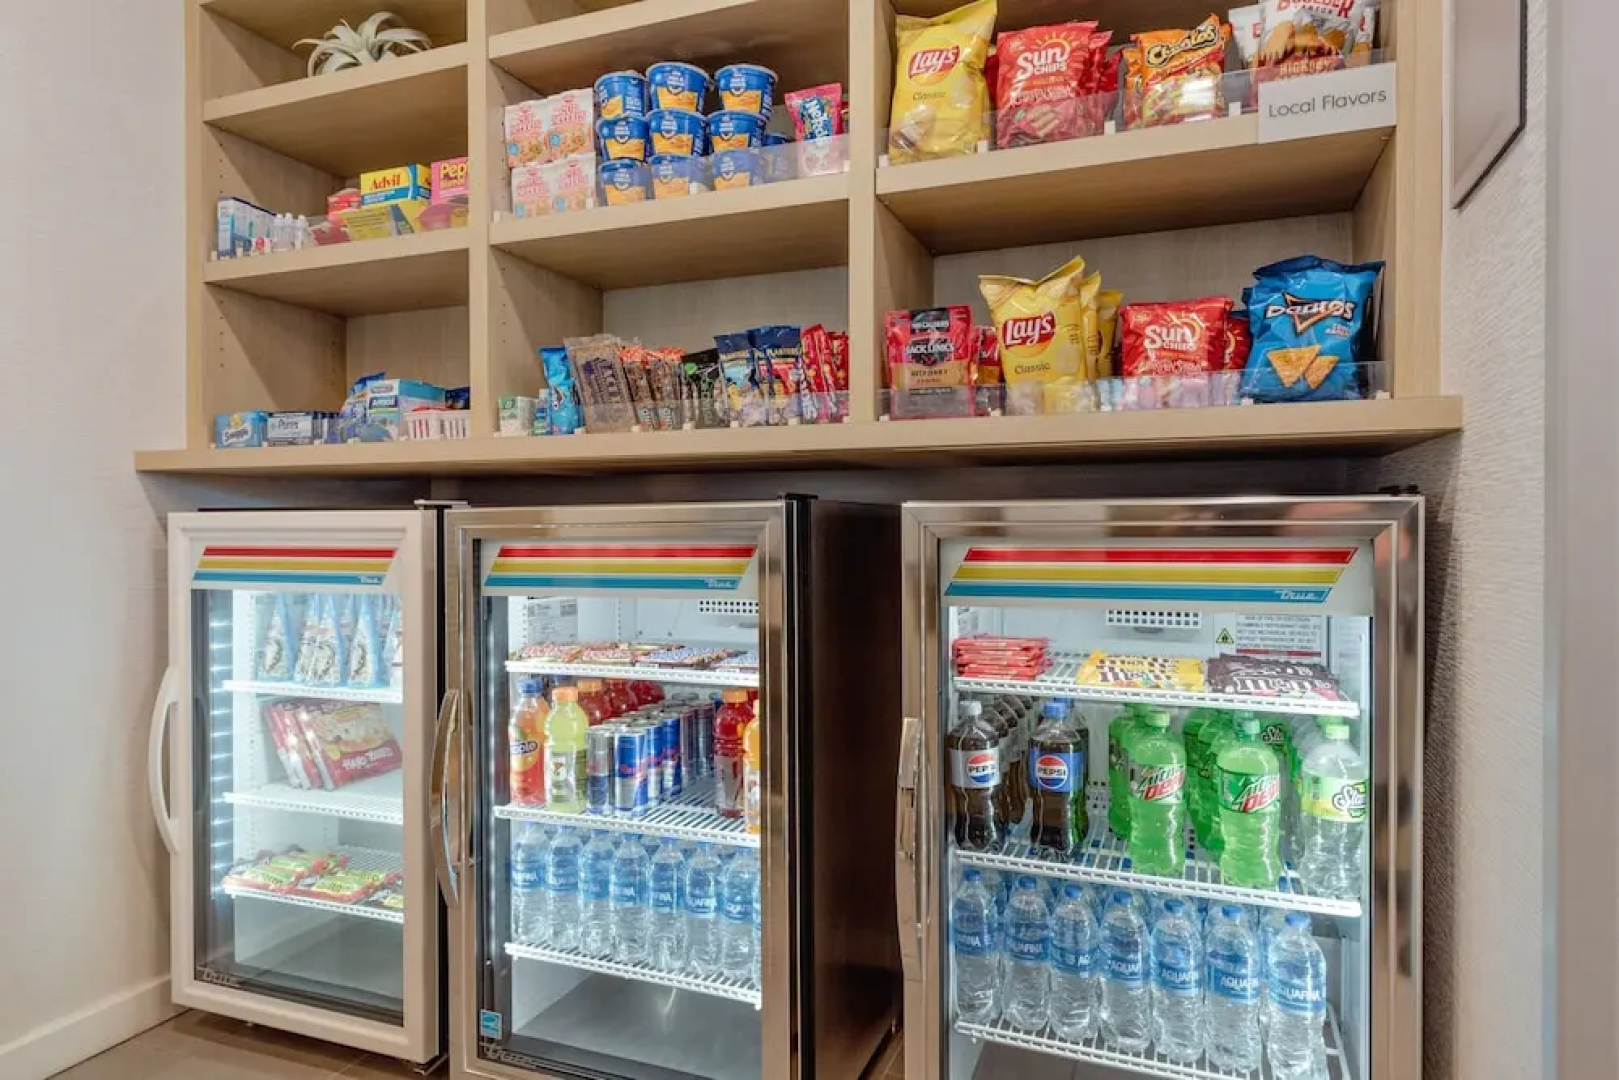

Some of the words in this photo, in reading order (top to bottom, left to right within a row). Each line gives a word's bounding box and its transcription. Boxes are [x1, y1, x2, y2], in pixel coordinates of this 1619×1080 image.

[1268, 98, 1316, 118] Local
[1321, 89, 1387, 110] Flavors
[1014, 362, 1051, 375] Classic
[1038, 767, 1067, 777] PEPSI
